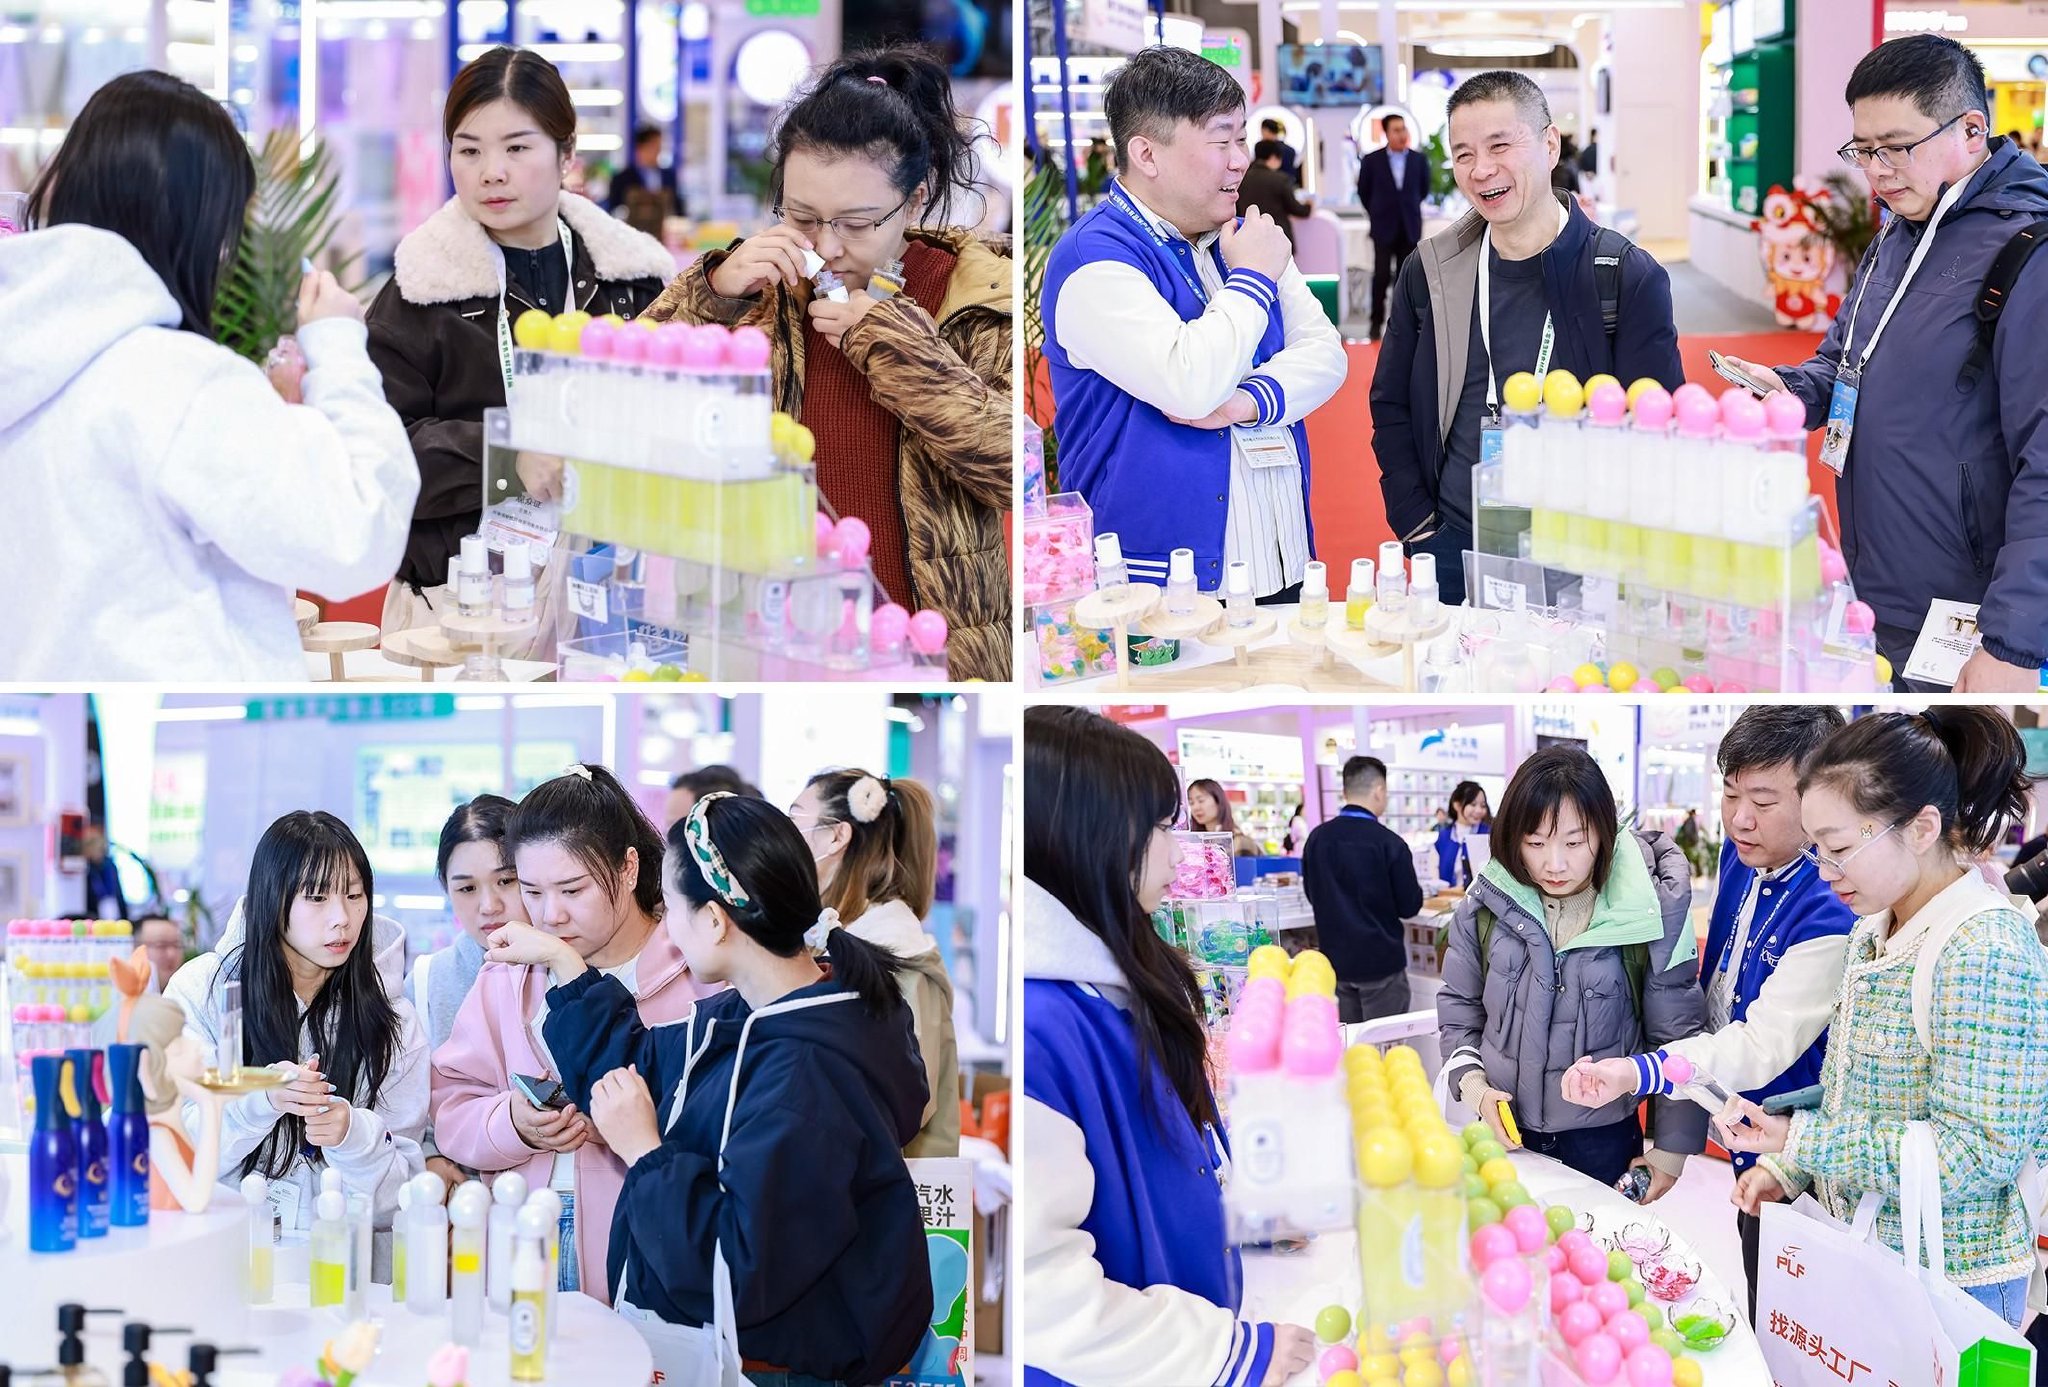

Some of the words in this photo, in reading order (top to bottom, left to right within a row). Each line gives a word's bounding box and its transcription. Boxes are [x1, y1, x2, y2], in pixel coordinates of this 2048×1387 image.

[915, 1184, 955, 1205] 汽水
[1776, 1255, 1806, 1279] PLF
[1769, 1309, 1872, 1384] 找源头工厂
